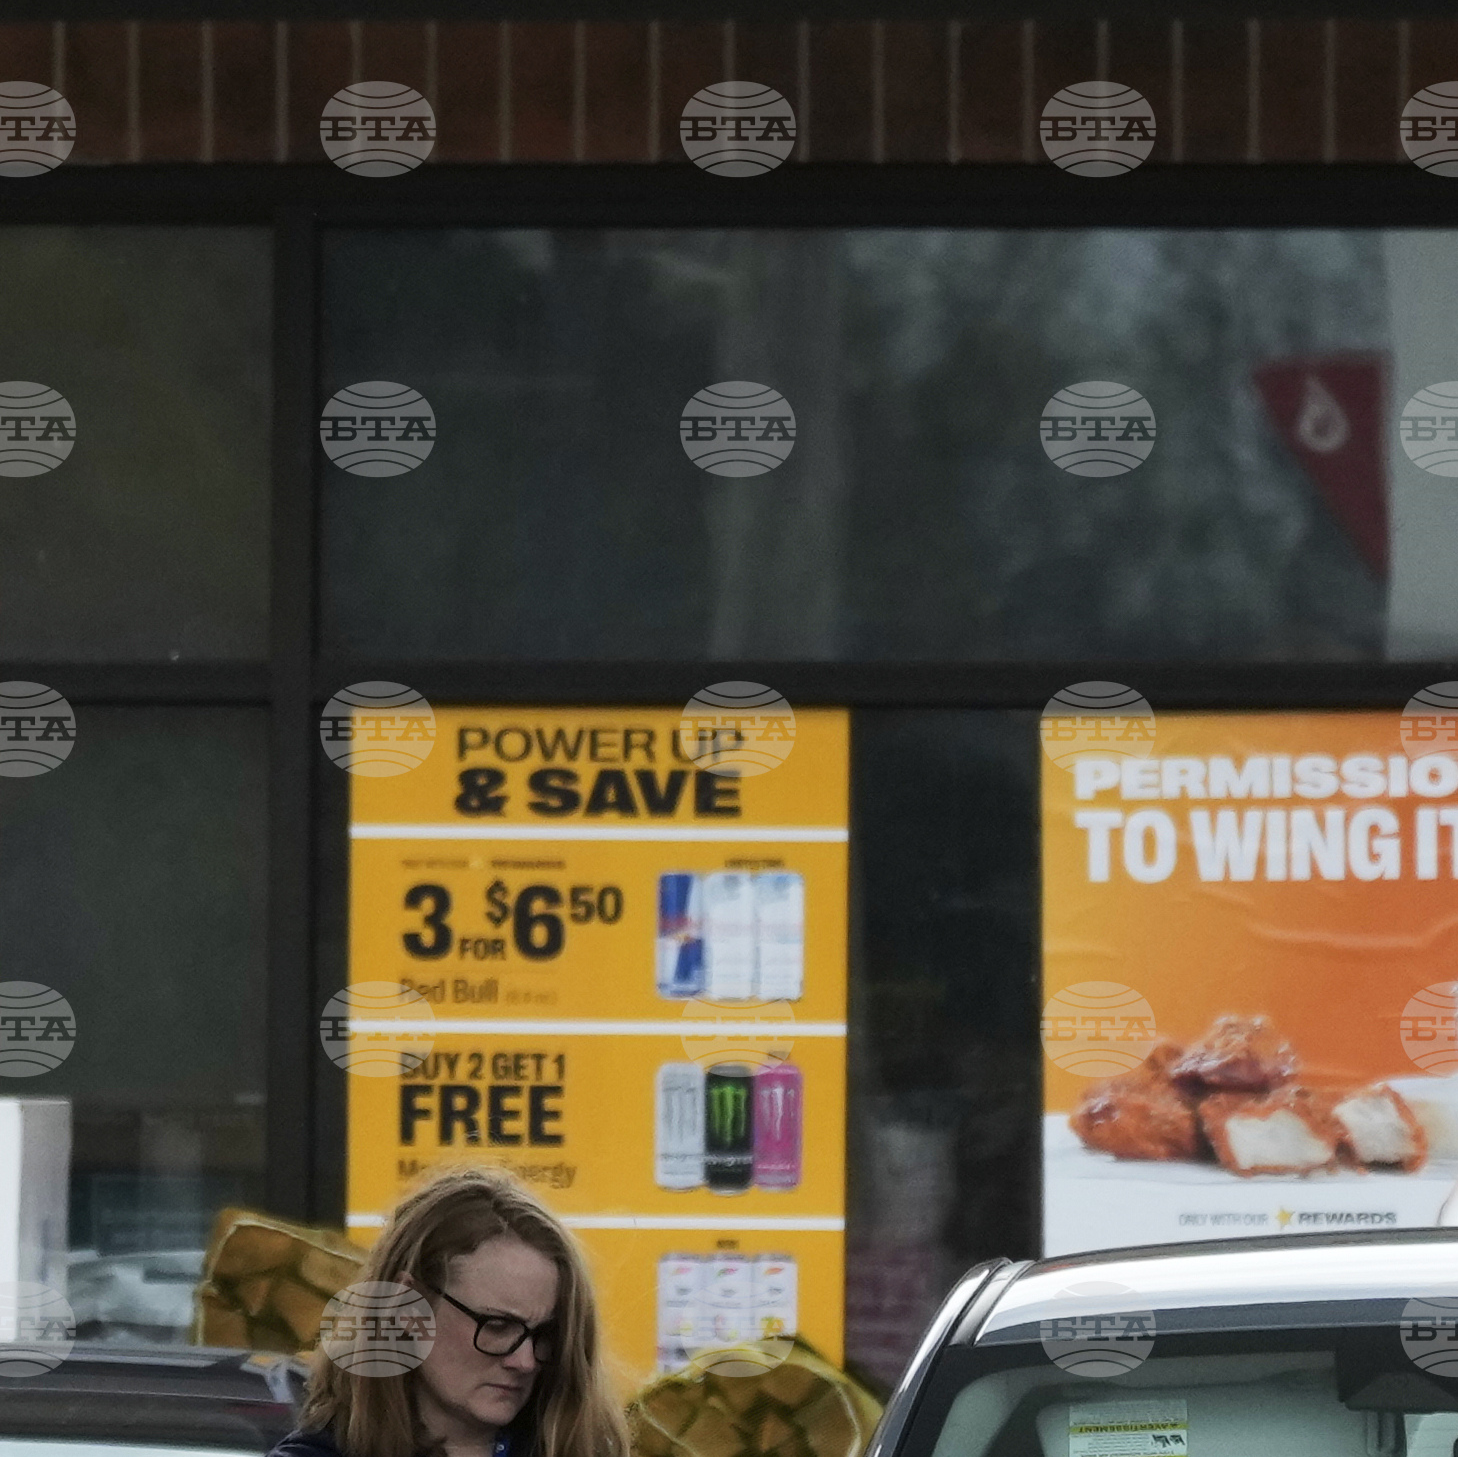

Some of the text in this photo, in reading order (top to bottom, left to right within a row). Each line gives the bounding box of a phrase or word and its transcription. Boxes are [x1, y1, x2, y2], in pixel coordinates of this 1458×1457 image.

[456, 727, 744, 763] POWER UP
[454, 767, 742, 818] & SAVE
[1075, 808, 1178, 883] TO
[1189, 806, 1400, 882] WING
[402, 883, 453, 960] 3
[459, 938, 507, 960] FOR
[453, 977, 499, 1004] Bull
[401, 1053, 567, 1080] BUY 2 GET 1
[400, 1084, 565, 1147] FREE
[1298, 1211, 1397, 1225] REWARDS
